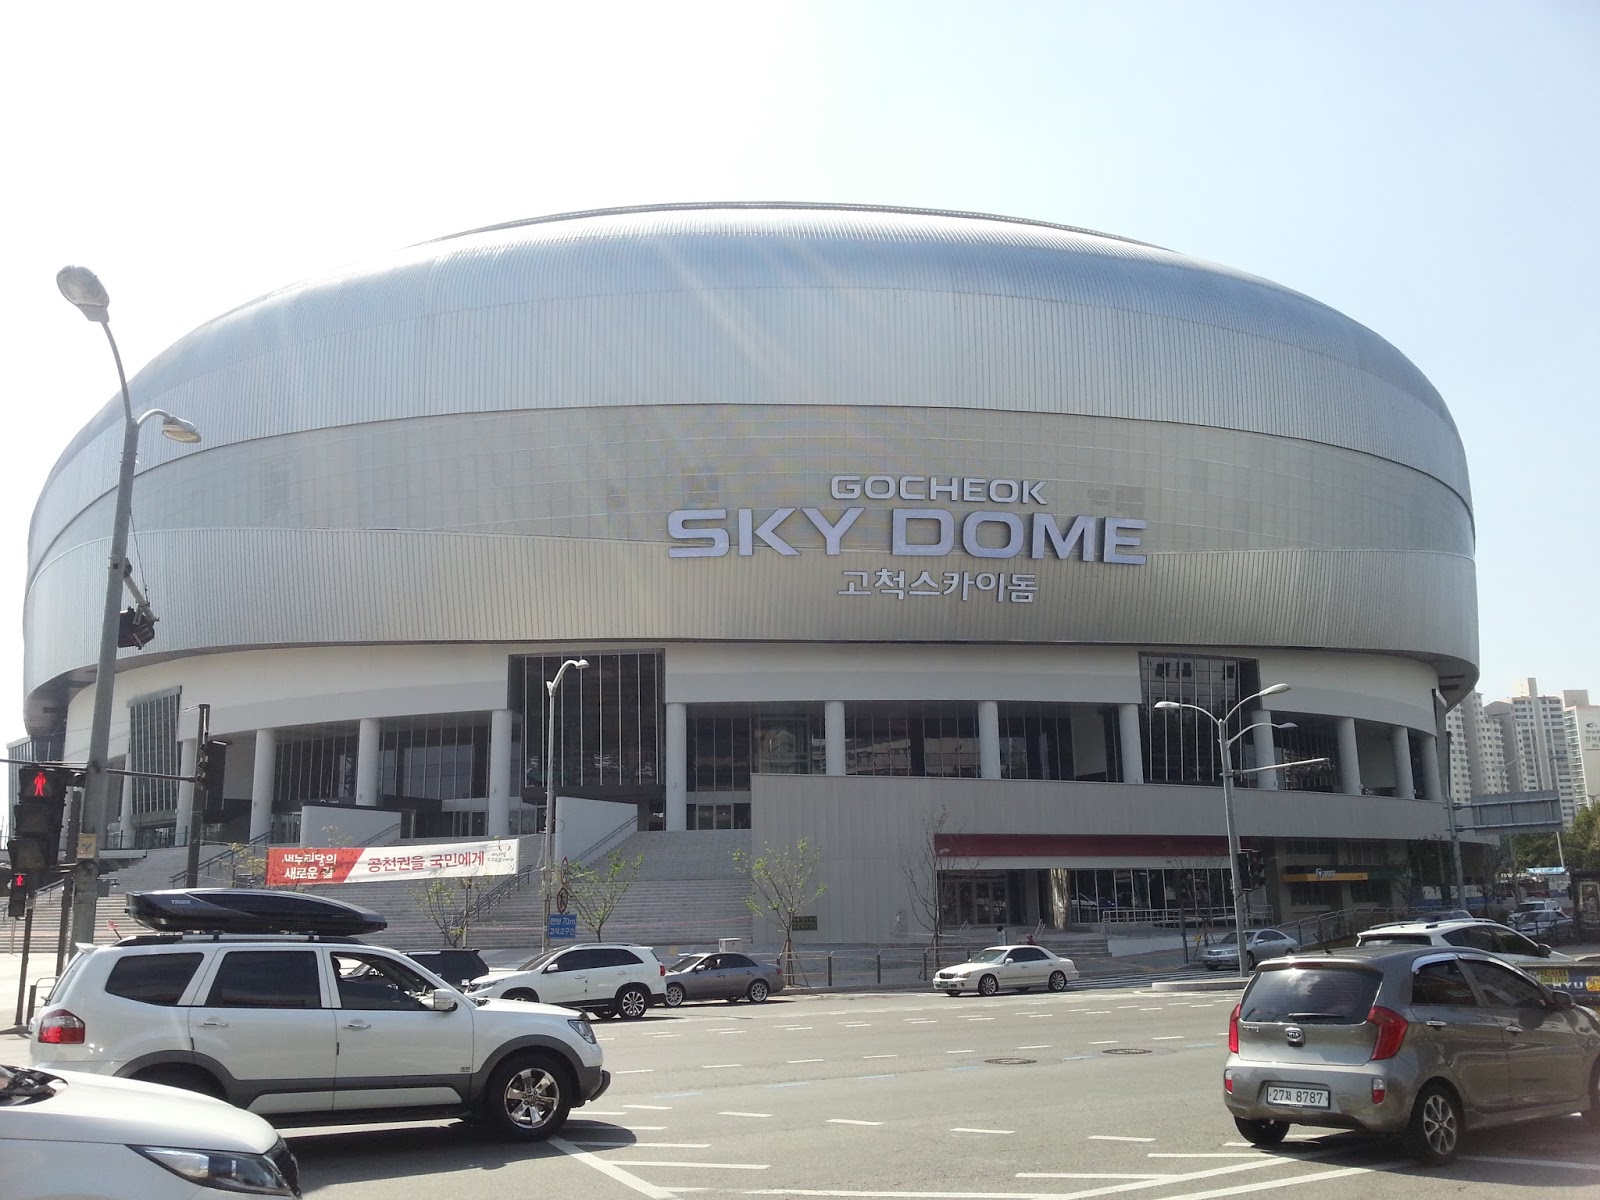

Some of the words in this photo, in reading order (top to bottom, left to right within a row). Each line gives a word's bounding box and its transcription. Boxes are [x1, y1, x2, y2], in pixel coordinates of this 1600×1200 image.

[831, 475, 1048, 505] GOCHEOK
[667, 506, 867, 559] SKY
[892, 508, 1148, 566] DOME
[838, 568, 1039, 603] 고척스카이돔
[284, 866, 318, 880] 새로운
[367, 855, 425, 873] 공천권을
[430, 850, 485, 869] 국민에게
[1296, 1090, 1323, 1104] 8787
